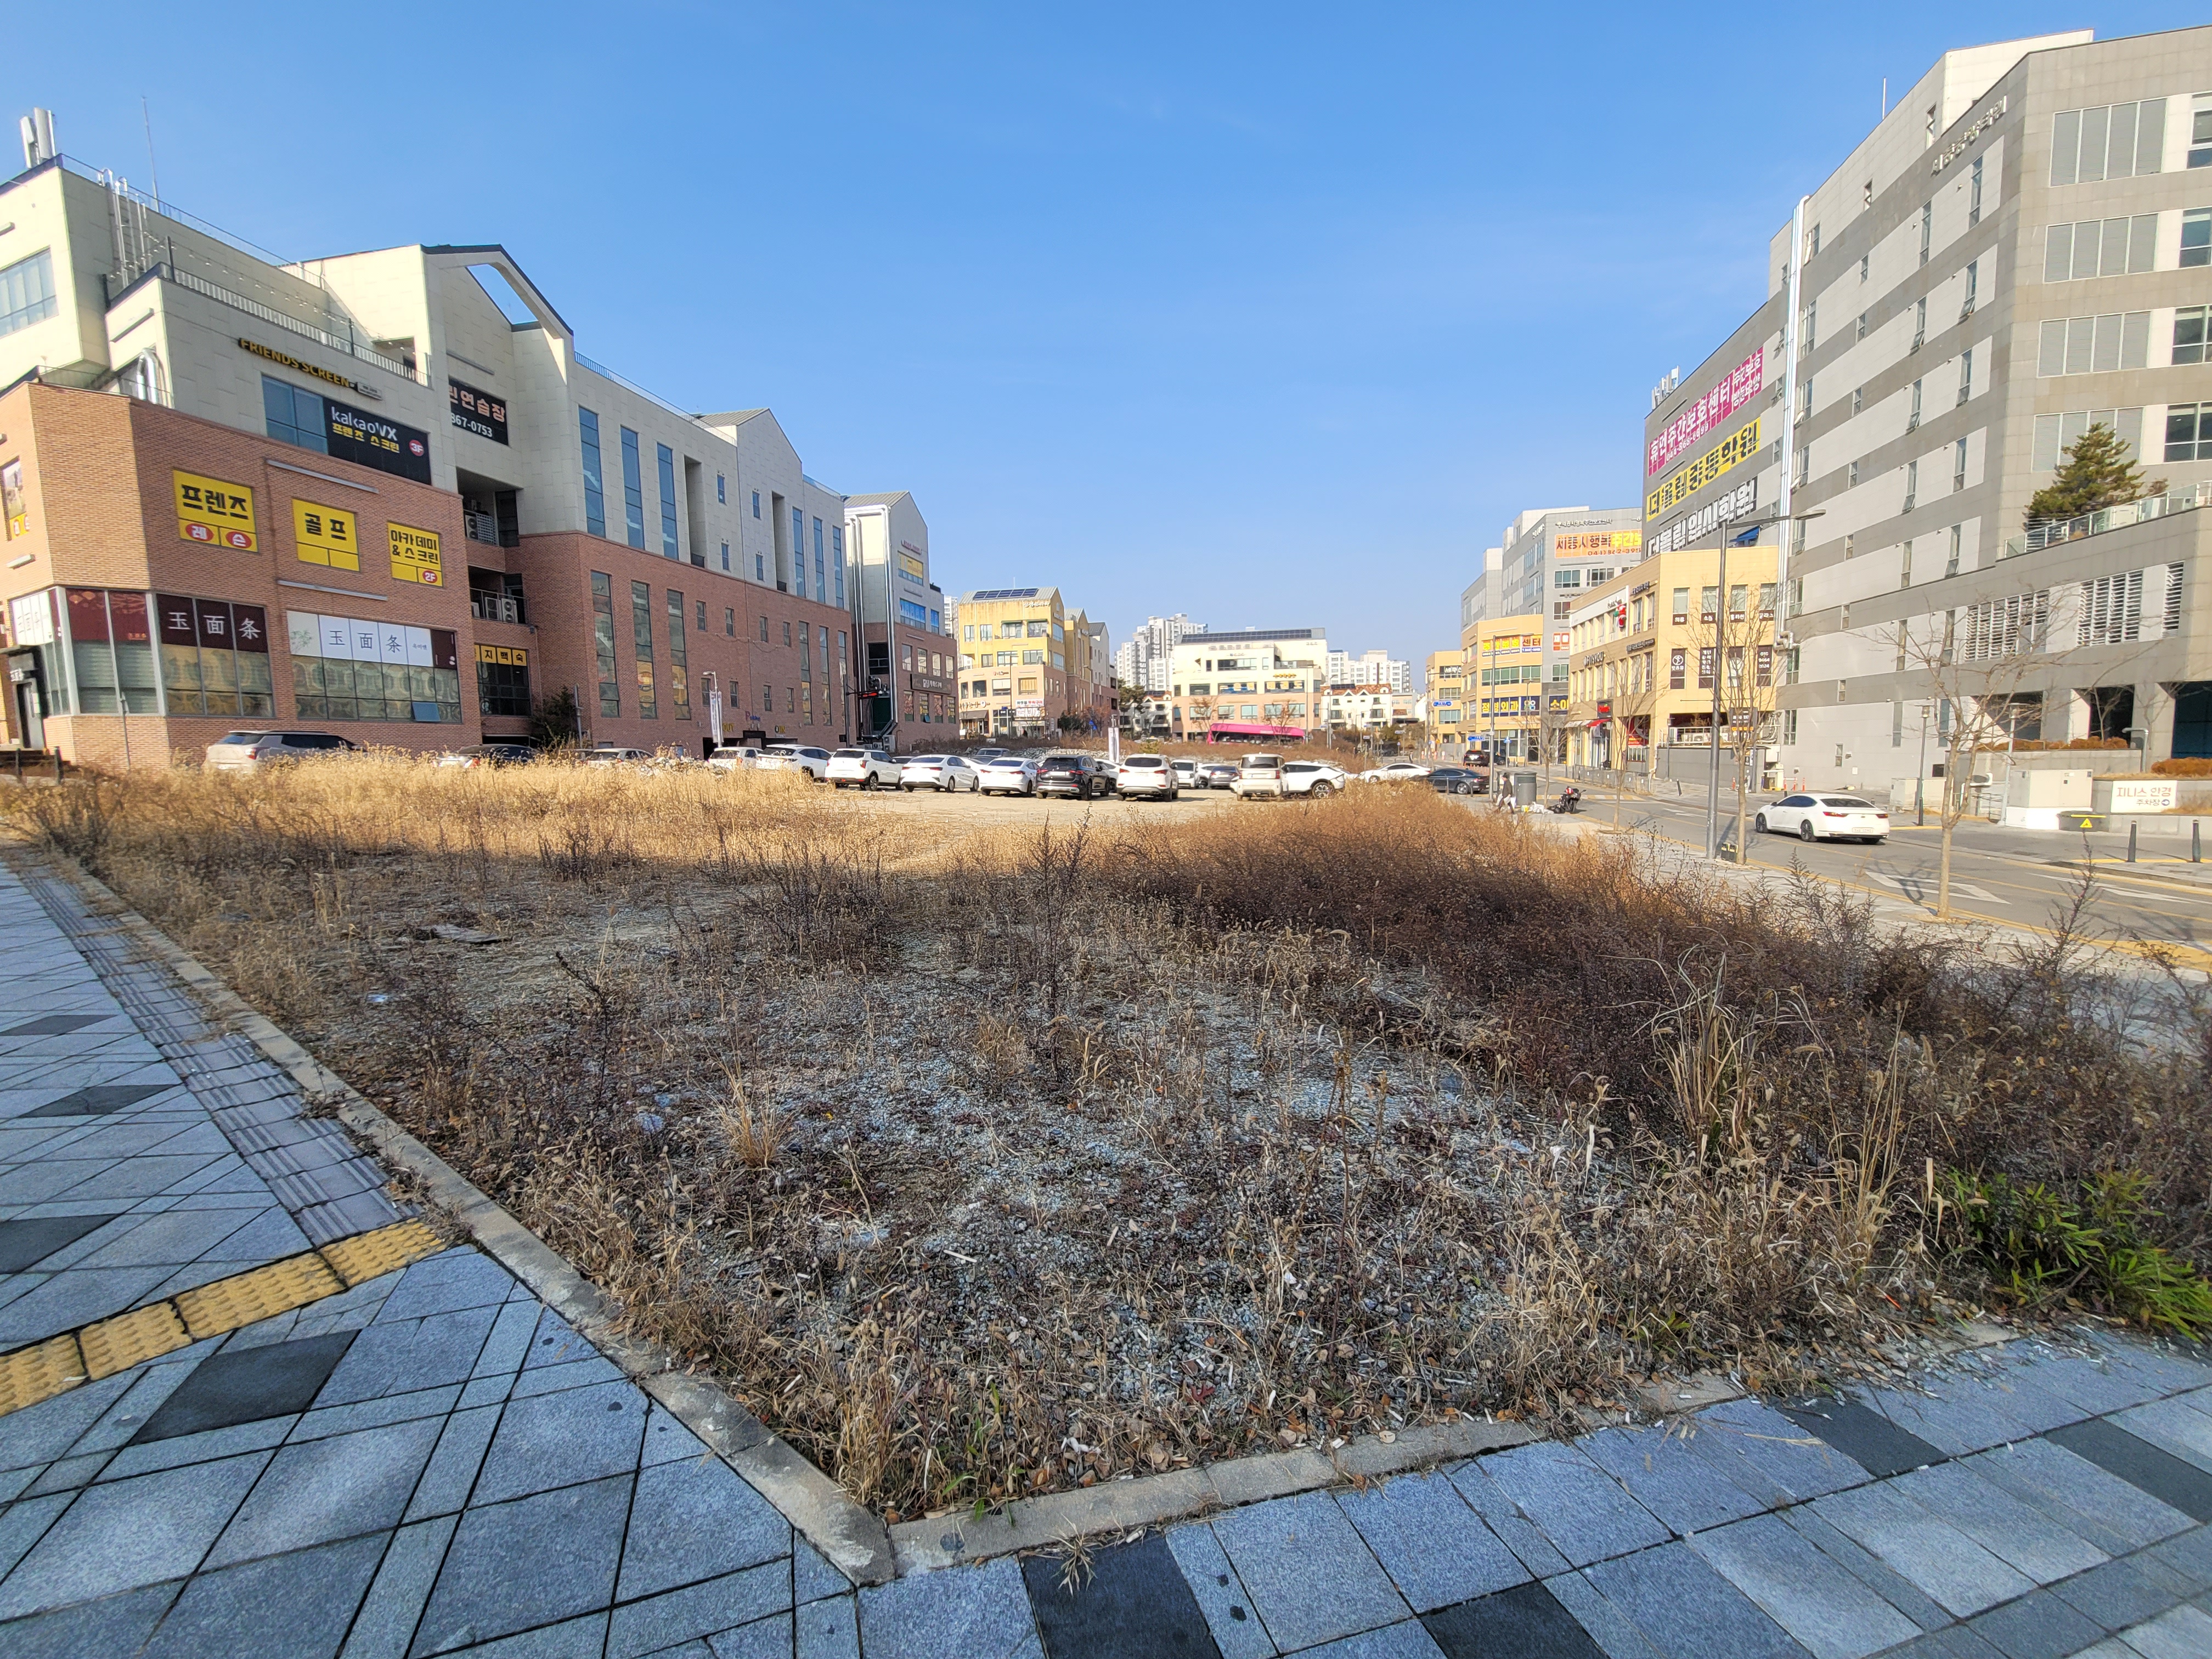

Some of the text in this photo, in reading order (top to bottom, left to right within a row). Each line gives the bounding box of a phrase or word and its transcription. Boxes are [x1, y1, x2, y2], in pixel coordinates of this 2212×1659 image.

[240, 338, 350, 387] FRIENDS SCREEN
[332, 423, 400, 453] 프렌즈 스크린
[411, 442, 424, 454] 3F
[182, 484, 249, 520] 프렌즈
[305, 512, 347, 541] 골프
[391, 530, 437, 551] 아카데미
[392, 545, 439, 565] & 스크린
[425, 572, 436, 582] 2F
[168, 612, 261, 639] 玉面条
[329, 630, 402, 653] 玉面条
[1523, 637, 1541, 647] 센터
[475, 648, 523, 663] 지백숙
[2117, 787, 2171, 797] 지니스 안경
